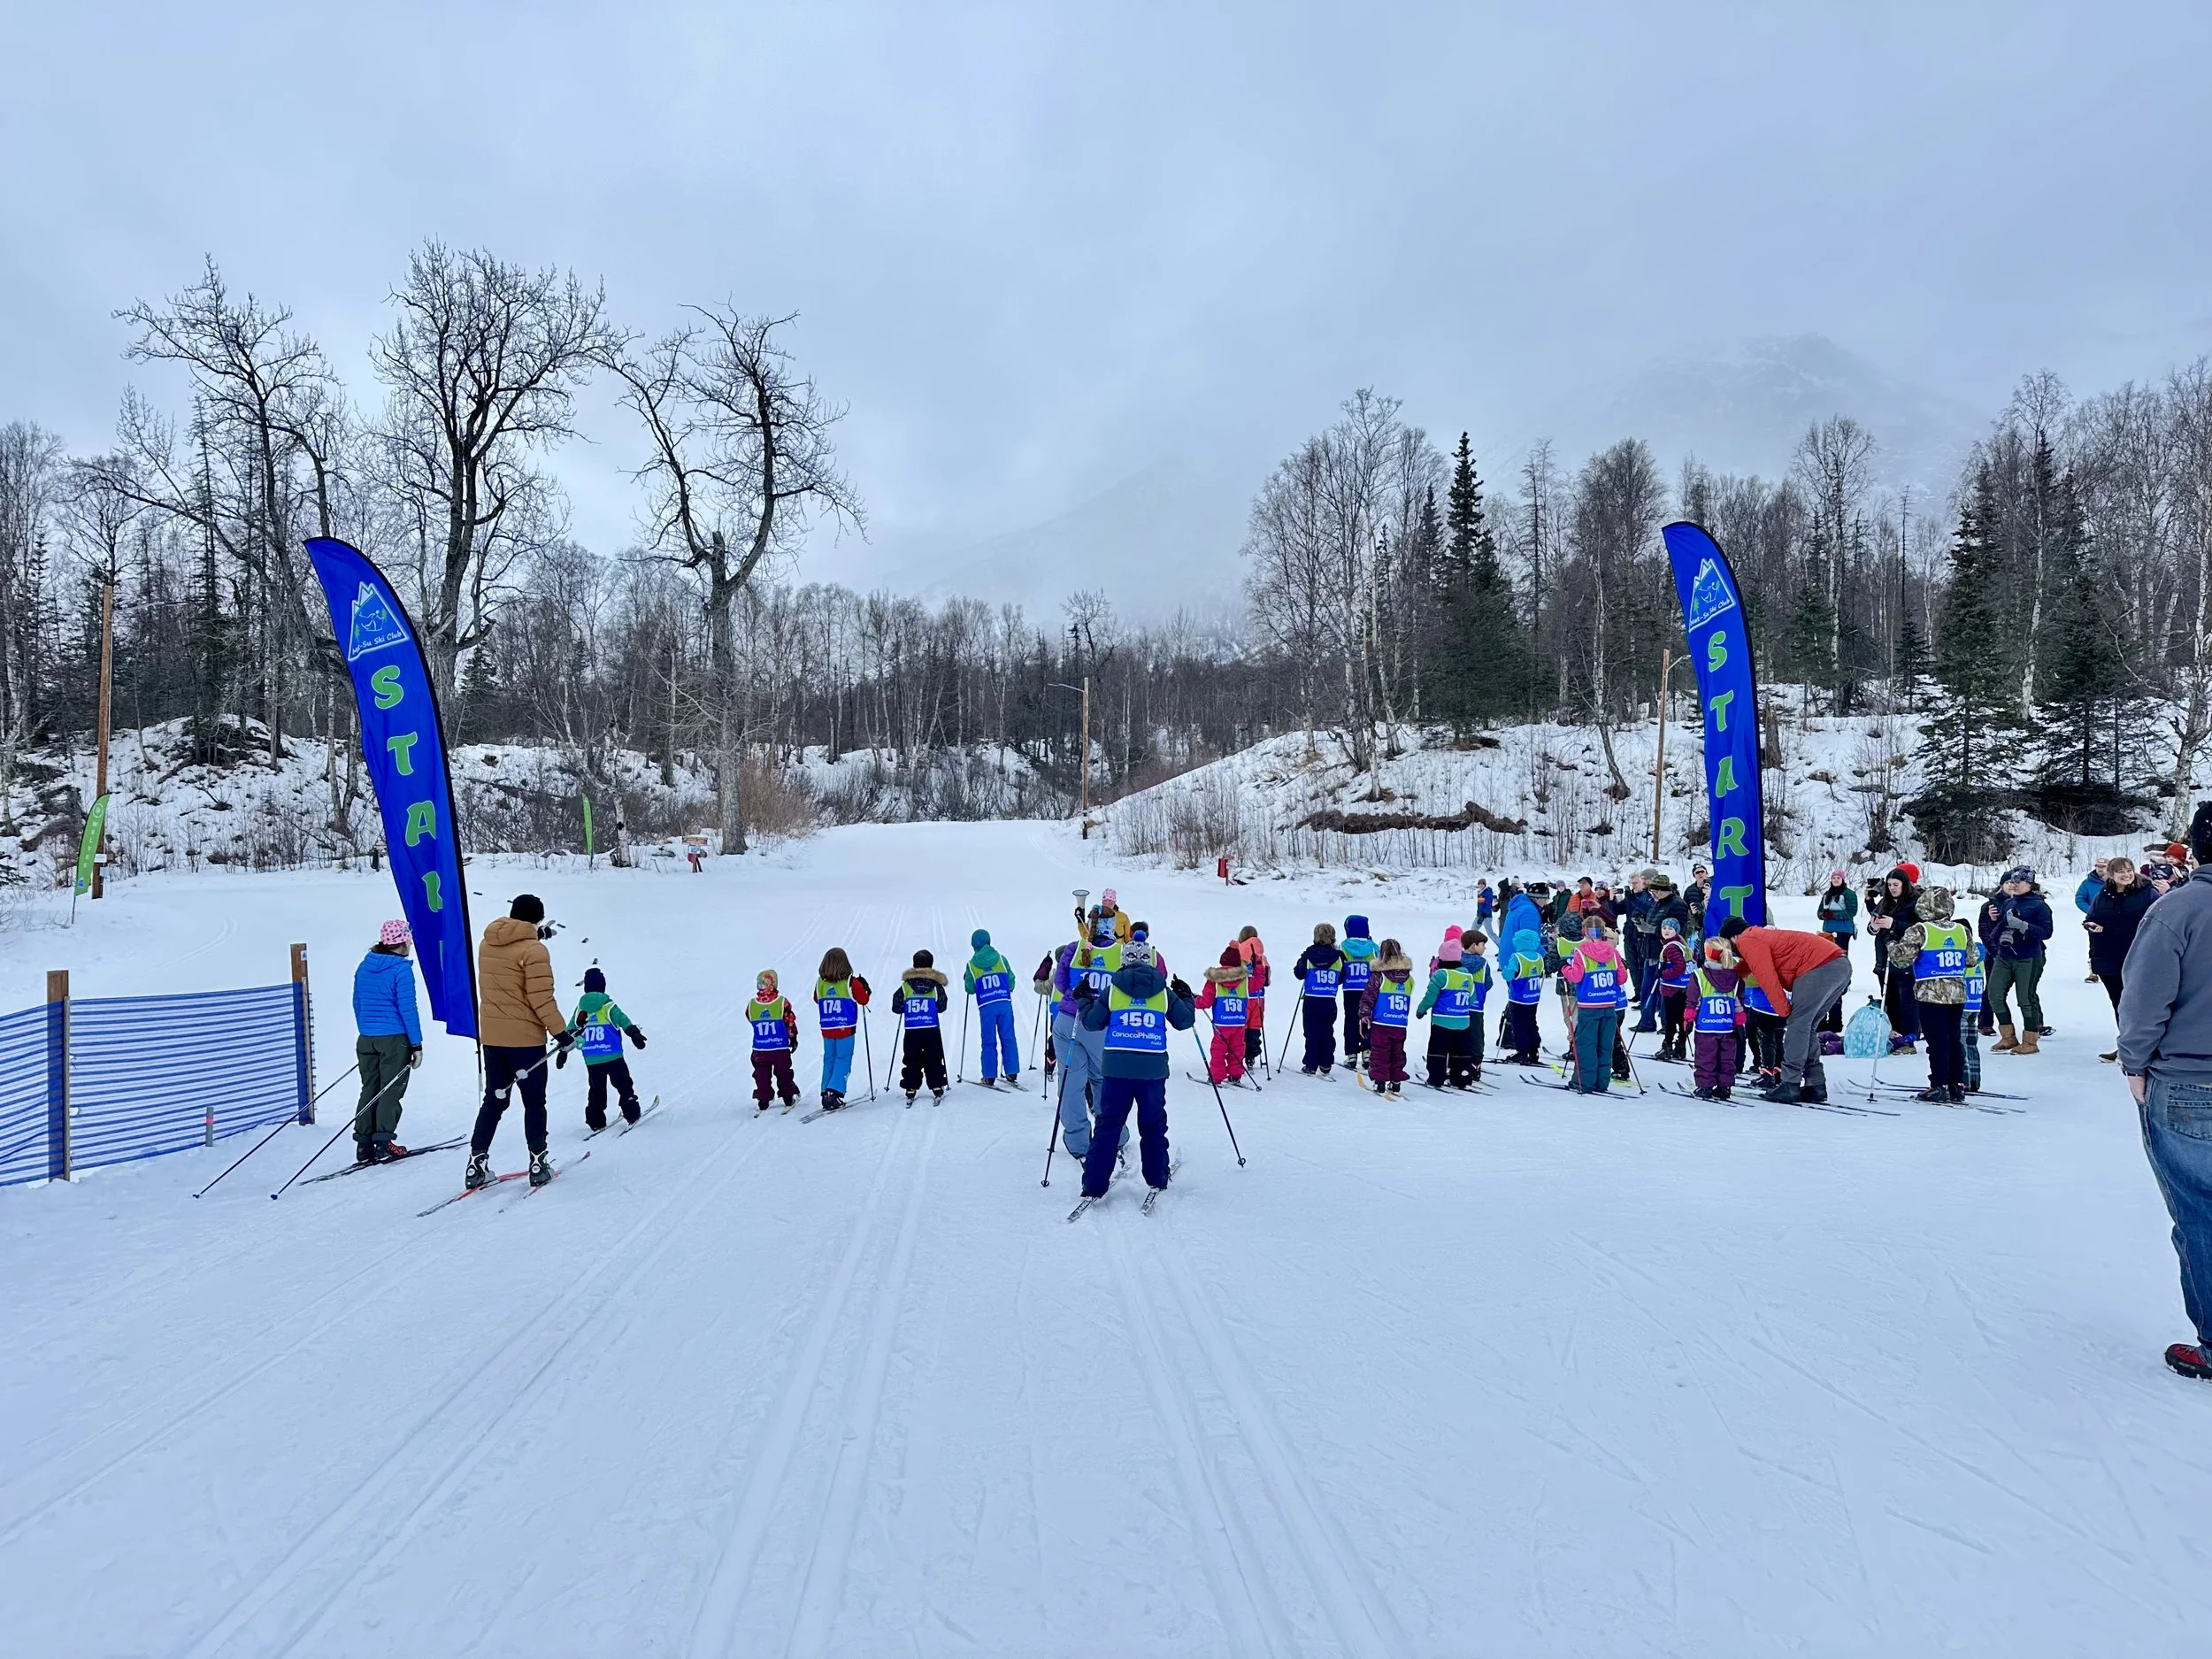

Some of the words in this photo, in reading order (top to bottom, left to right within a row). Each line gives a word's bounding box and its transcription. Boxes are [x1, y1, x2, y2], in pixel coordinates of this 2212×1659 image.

[1718, 597, 1730, 609] Club
[373, 634, 385, 645] Ski
[387, 630, 402, 641] Club
[1708, 630, 1754, 921] START
[1315, 970, 1336, 984] 159
[1348, 963, 1368, 976] 176
[981, 974, 1001, 990] 170
[1590, 972, 1614, 988] 160
[823, 1000, 842, 1014] 174
[905, 999, 929, 1013] 154
[1707, 998, 1732, 1015] 161
[1119, 1011, 1156, 1028] 150
[581, 1026, 605, 1042] 178
[756, 1021, 777, 1036] 171
[1111, 1030, 1162, 1041] ConocoPhillips
